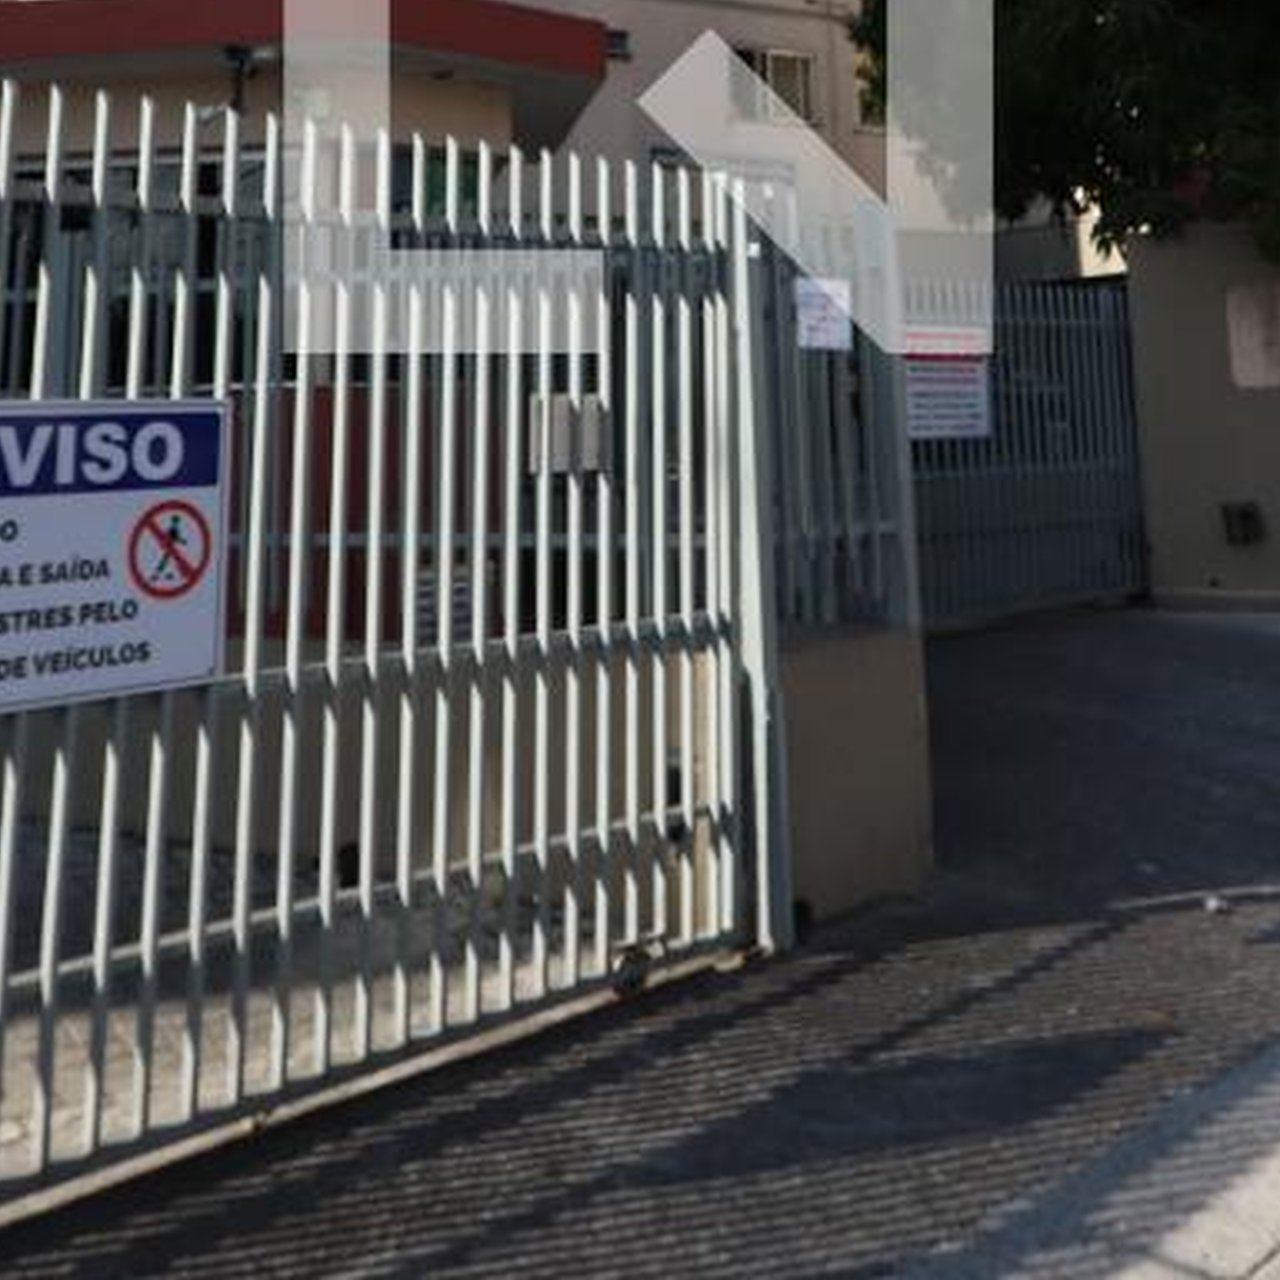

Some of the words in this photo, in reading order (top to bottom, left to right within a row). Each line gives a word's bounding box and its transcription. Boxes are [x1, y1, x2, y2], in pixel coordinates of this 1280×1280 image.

[19, 564, 35, 585] E
[40, 554, 110, 582] SAÍDA
[79, 599, 138, 622] PELO
[33, 641, 151, 673] VEÍCULOS
